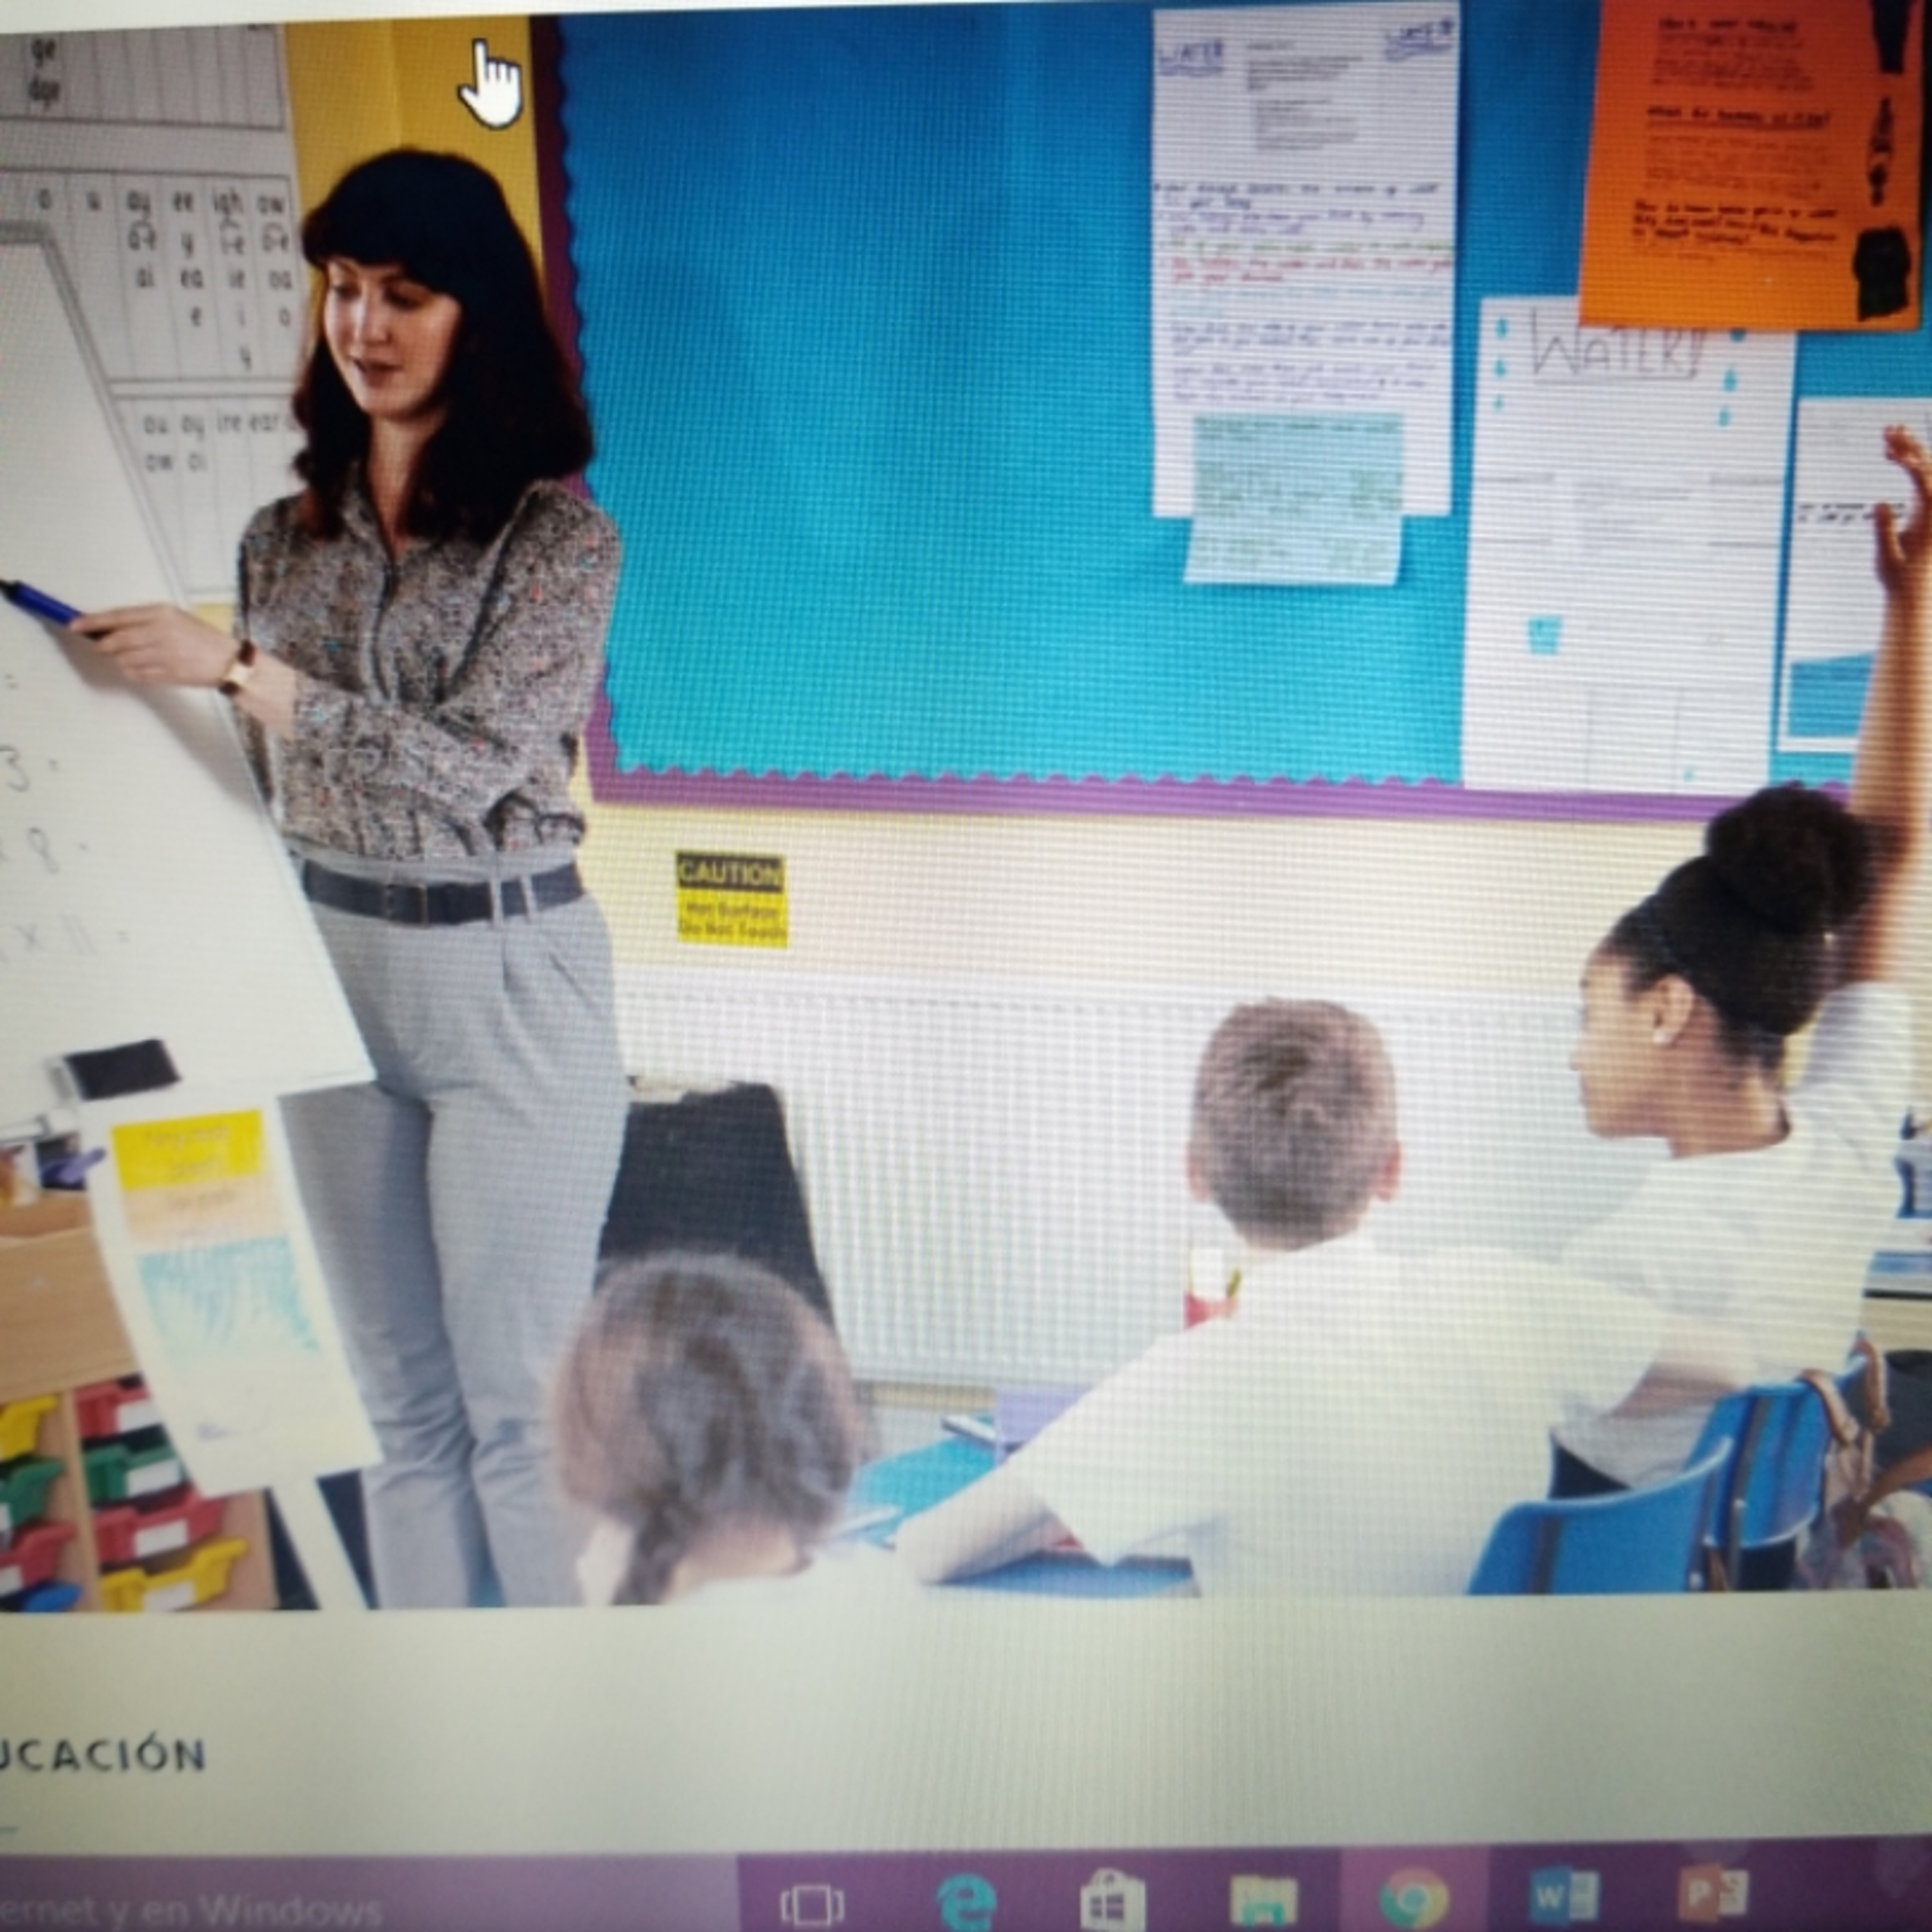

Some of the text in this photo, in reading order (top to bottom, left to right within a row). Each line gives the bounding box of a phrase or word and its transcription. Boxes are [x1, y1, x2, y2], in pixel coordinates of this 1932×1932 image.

[677, 858, 782, 886] CAUTION
[141, 1900, 190, 1926] en
[198, 1893, 384, 1926] Windows
